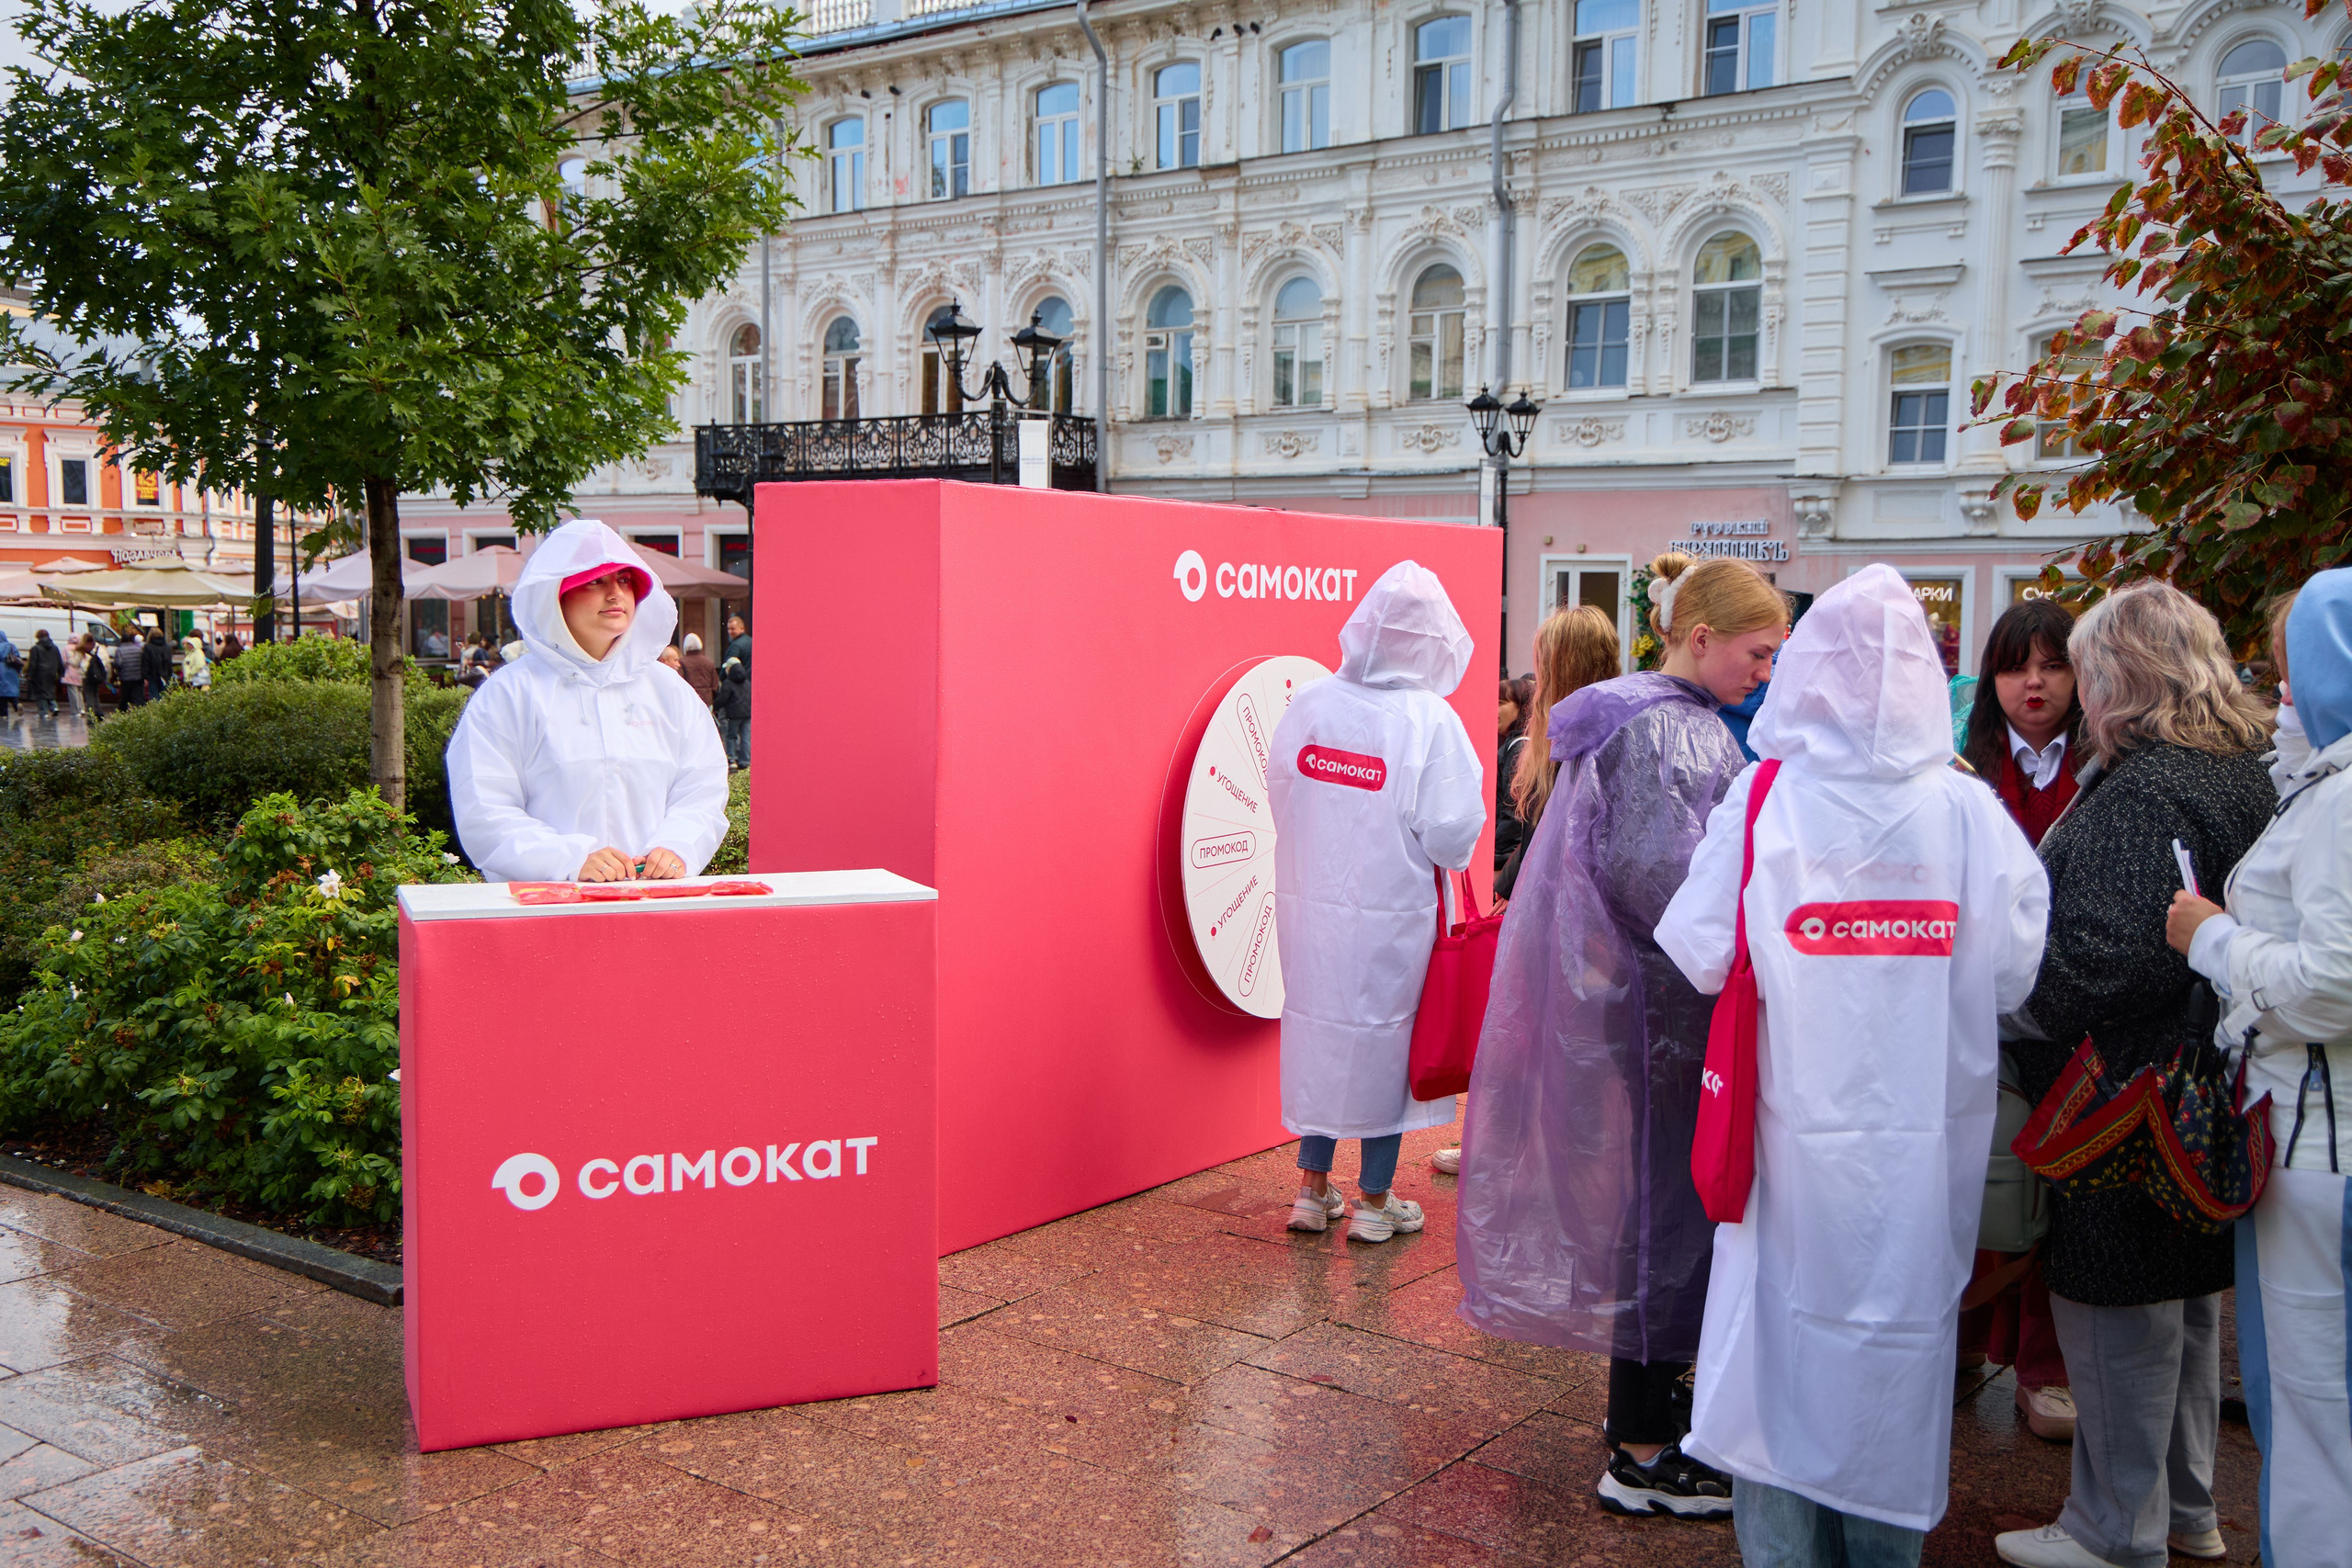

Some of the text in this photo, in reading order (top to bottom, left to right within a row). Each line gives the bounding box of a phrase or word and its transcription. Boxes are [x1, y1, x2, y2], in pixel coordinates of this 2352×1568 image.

[1216, 562, 1357, 601] самокат
[1317, 759, 1382, 782] самокат
[1216, 772, 1258, 813] УГОЩЕНИЕ
[1200, 840, 1249, 860] ПРОМОКОД
[1217, 875, 1259, 929] УГОЩЕНИЕ
[1244, 905, 1272, 983] ПРОМОКОД
[1832, 919, 1957, 939] самокат
[578, 1135, 878, 1200] самокат
